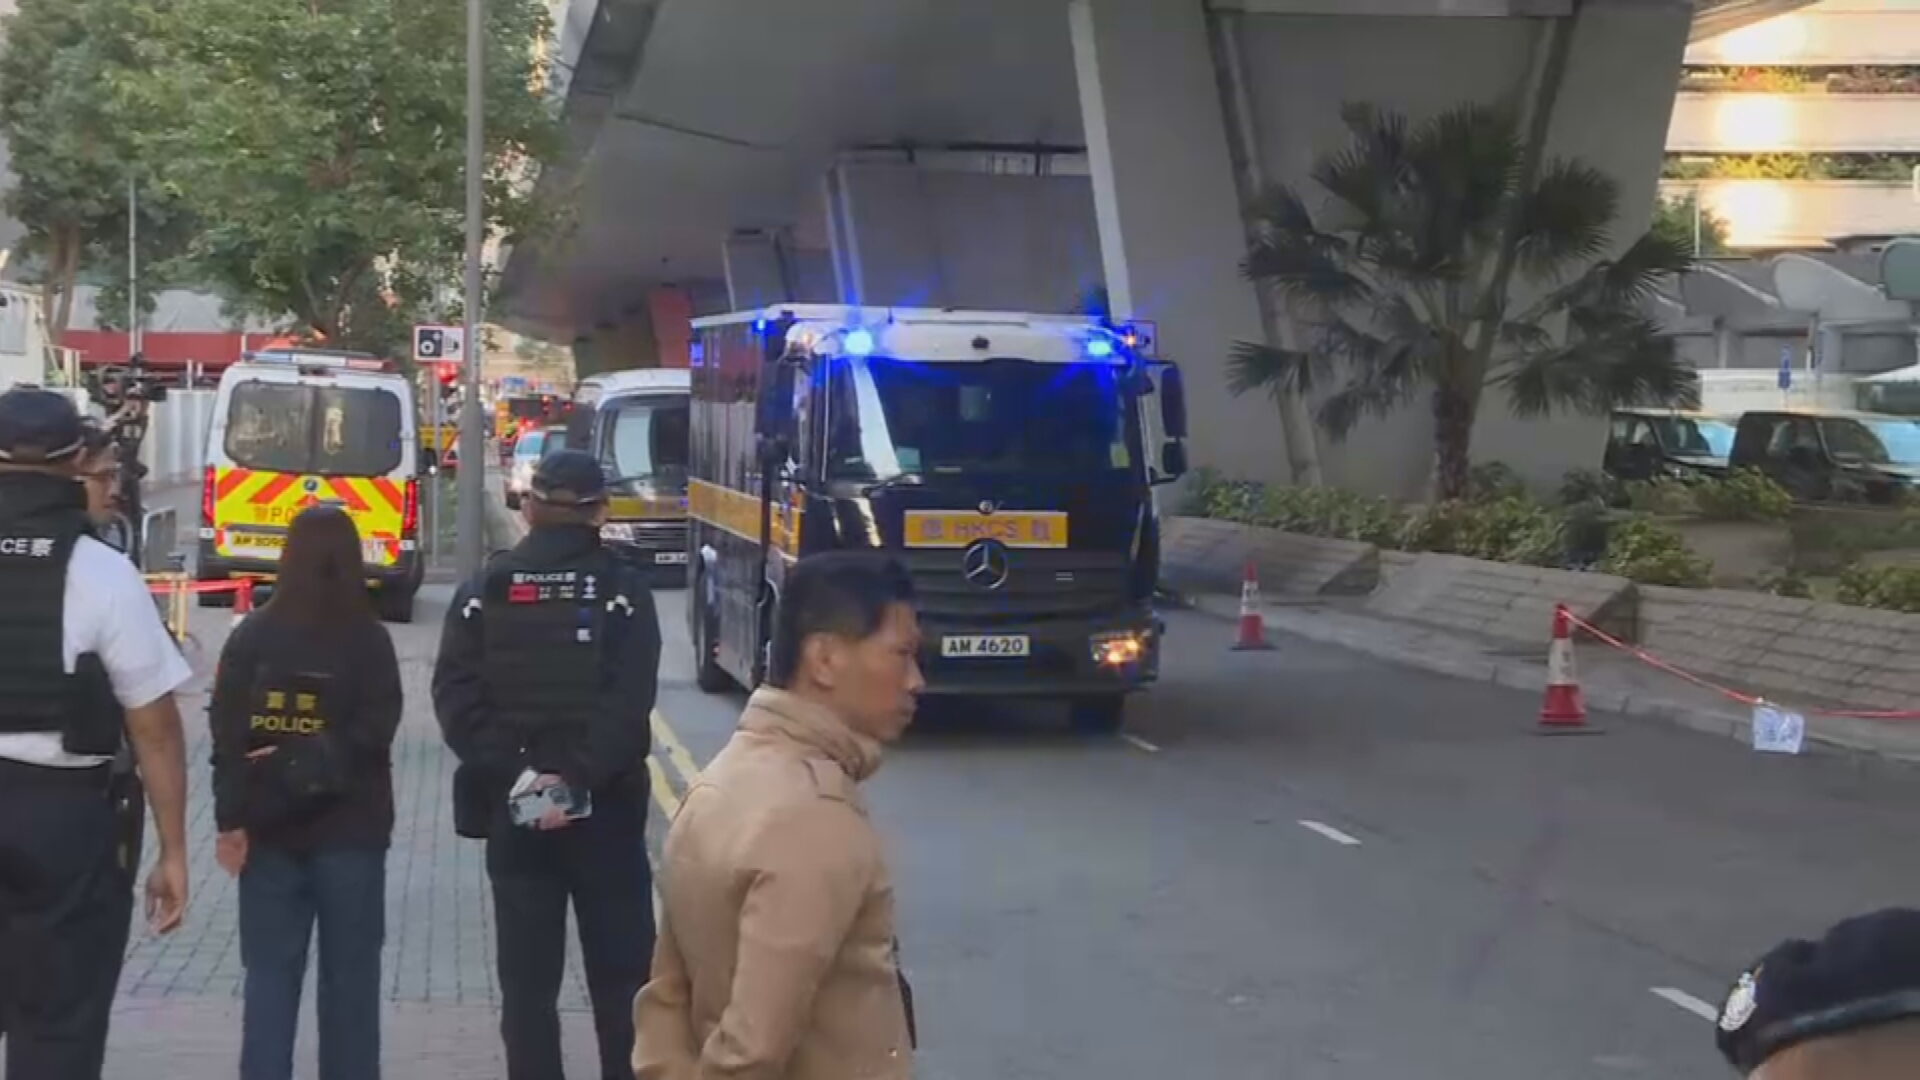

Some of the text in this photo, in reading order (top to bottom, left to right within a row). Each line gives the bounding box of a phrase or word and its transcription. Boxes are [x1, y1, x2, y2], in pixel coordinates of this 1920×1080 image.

[954, 520, 1018, 538] HKCS
[949, 639, 1024, 653] AM 4620
[250, 715, 326, 733] POLICE
